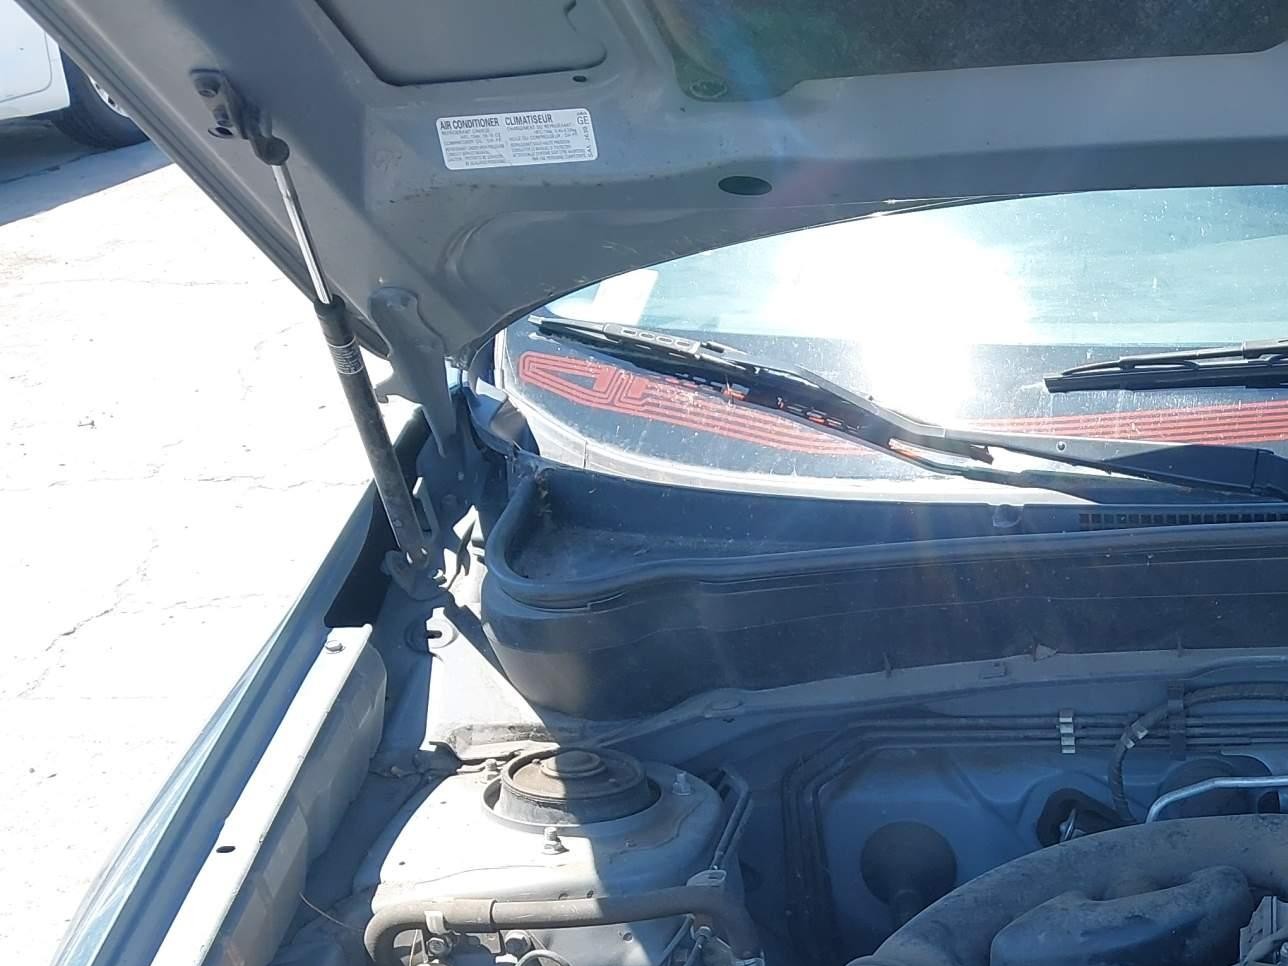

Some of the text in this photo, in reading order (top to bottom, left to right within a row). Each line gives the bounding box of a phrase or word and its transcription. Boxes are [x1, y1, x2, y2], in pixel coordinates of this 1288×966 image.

[440, 117, 500, 130] AIR CONDITIONER
[504, 114, 553, 126] CLIMATISEUR
[577, 116, 590, 125] GE
